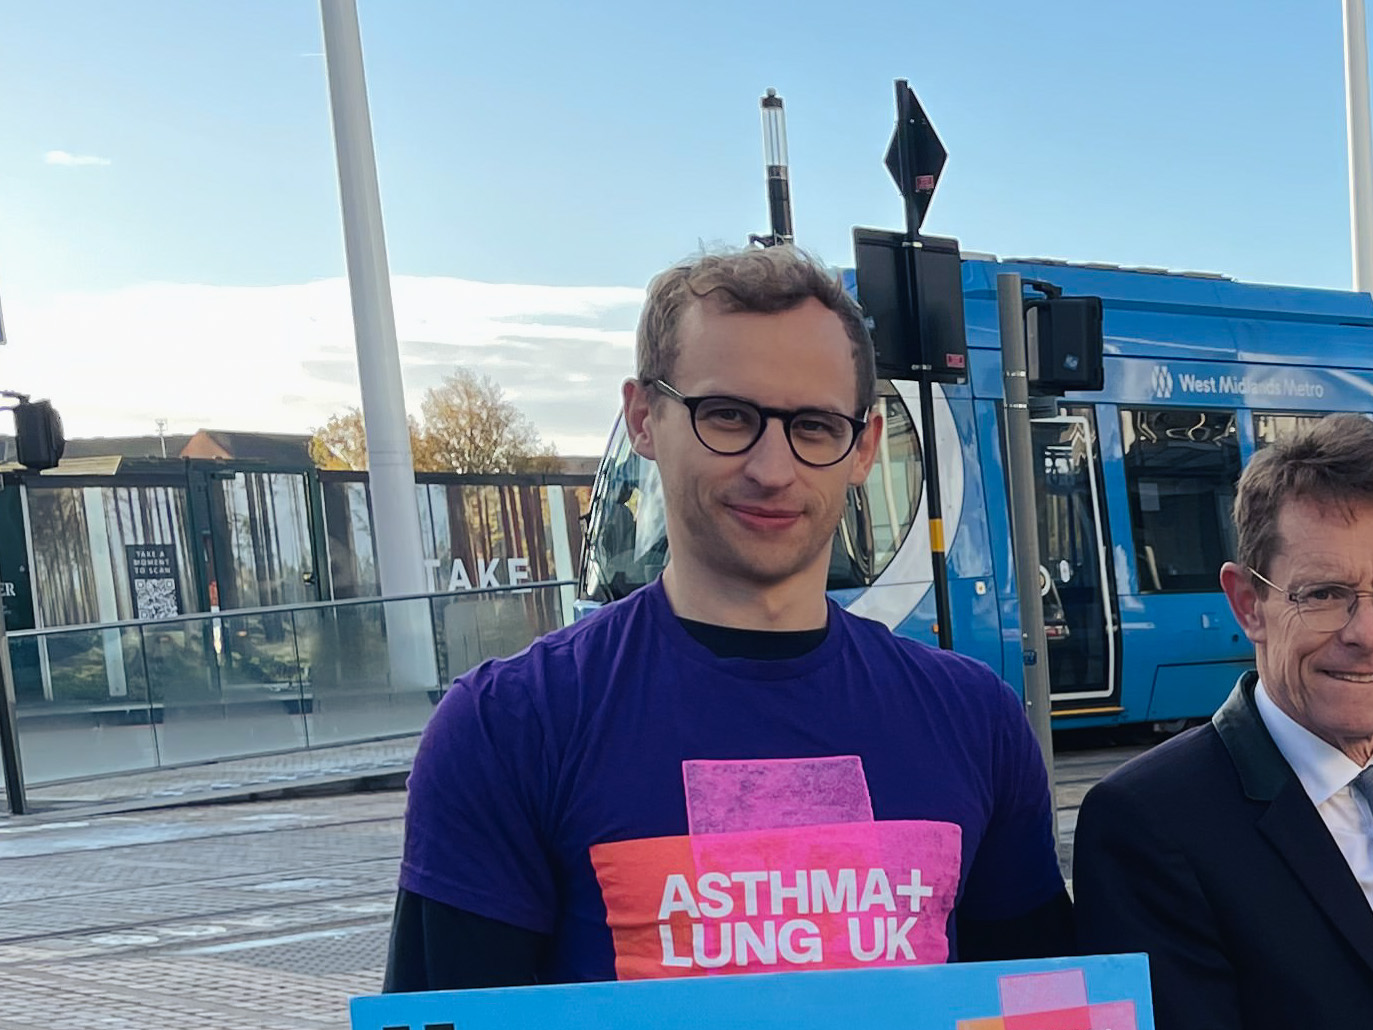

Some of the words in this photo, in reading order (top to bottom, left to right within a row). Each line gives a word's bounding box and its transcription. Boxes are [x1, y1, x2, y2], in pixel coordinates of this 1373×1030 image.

[1178, 374, 1216, 393] West
[1219, 375, 1281, 396] Midlands
[1283, 378, 1324, 398] Metro
[133, 558, 170, 567] MOMENT
[136, 550, 156, 559] TAKE
[159, 550, 165, 558] A
[424, 557, 532, 594] TAKE
[658, 868, 933, 920] ASTHMA+
[658, 919, 823, 968] LUNG
[848, 916, 918, 962] UK
